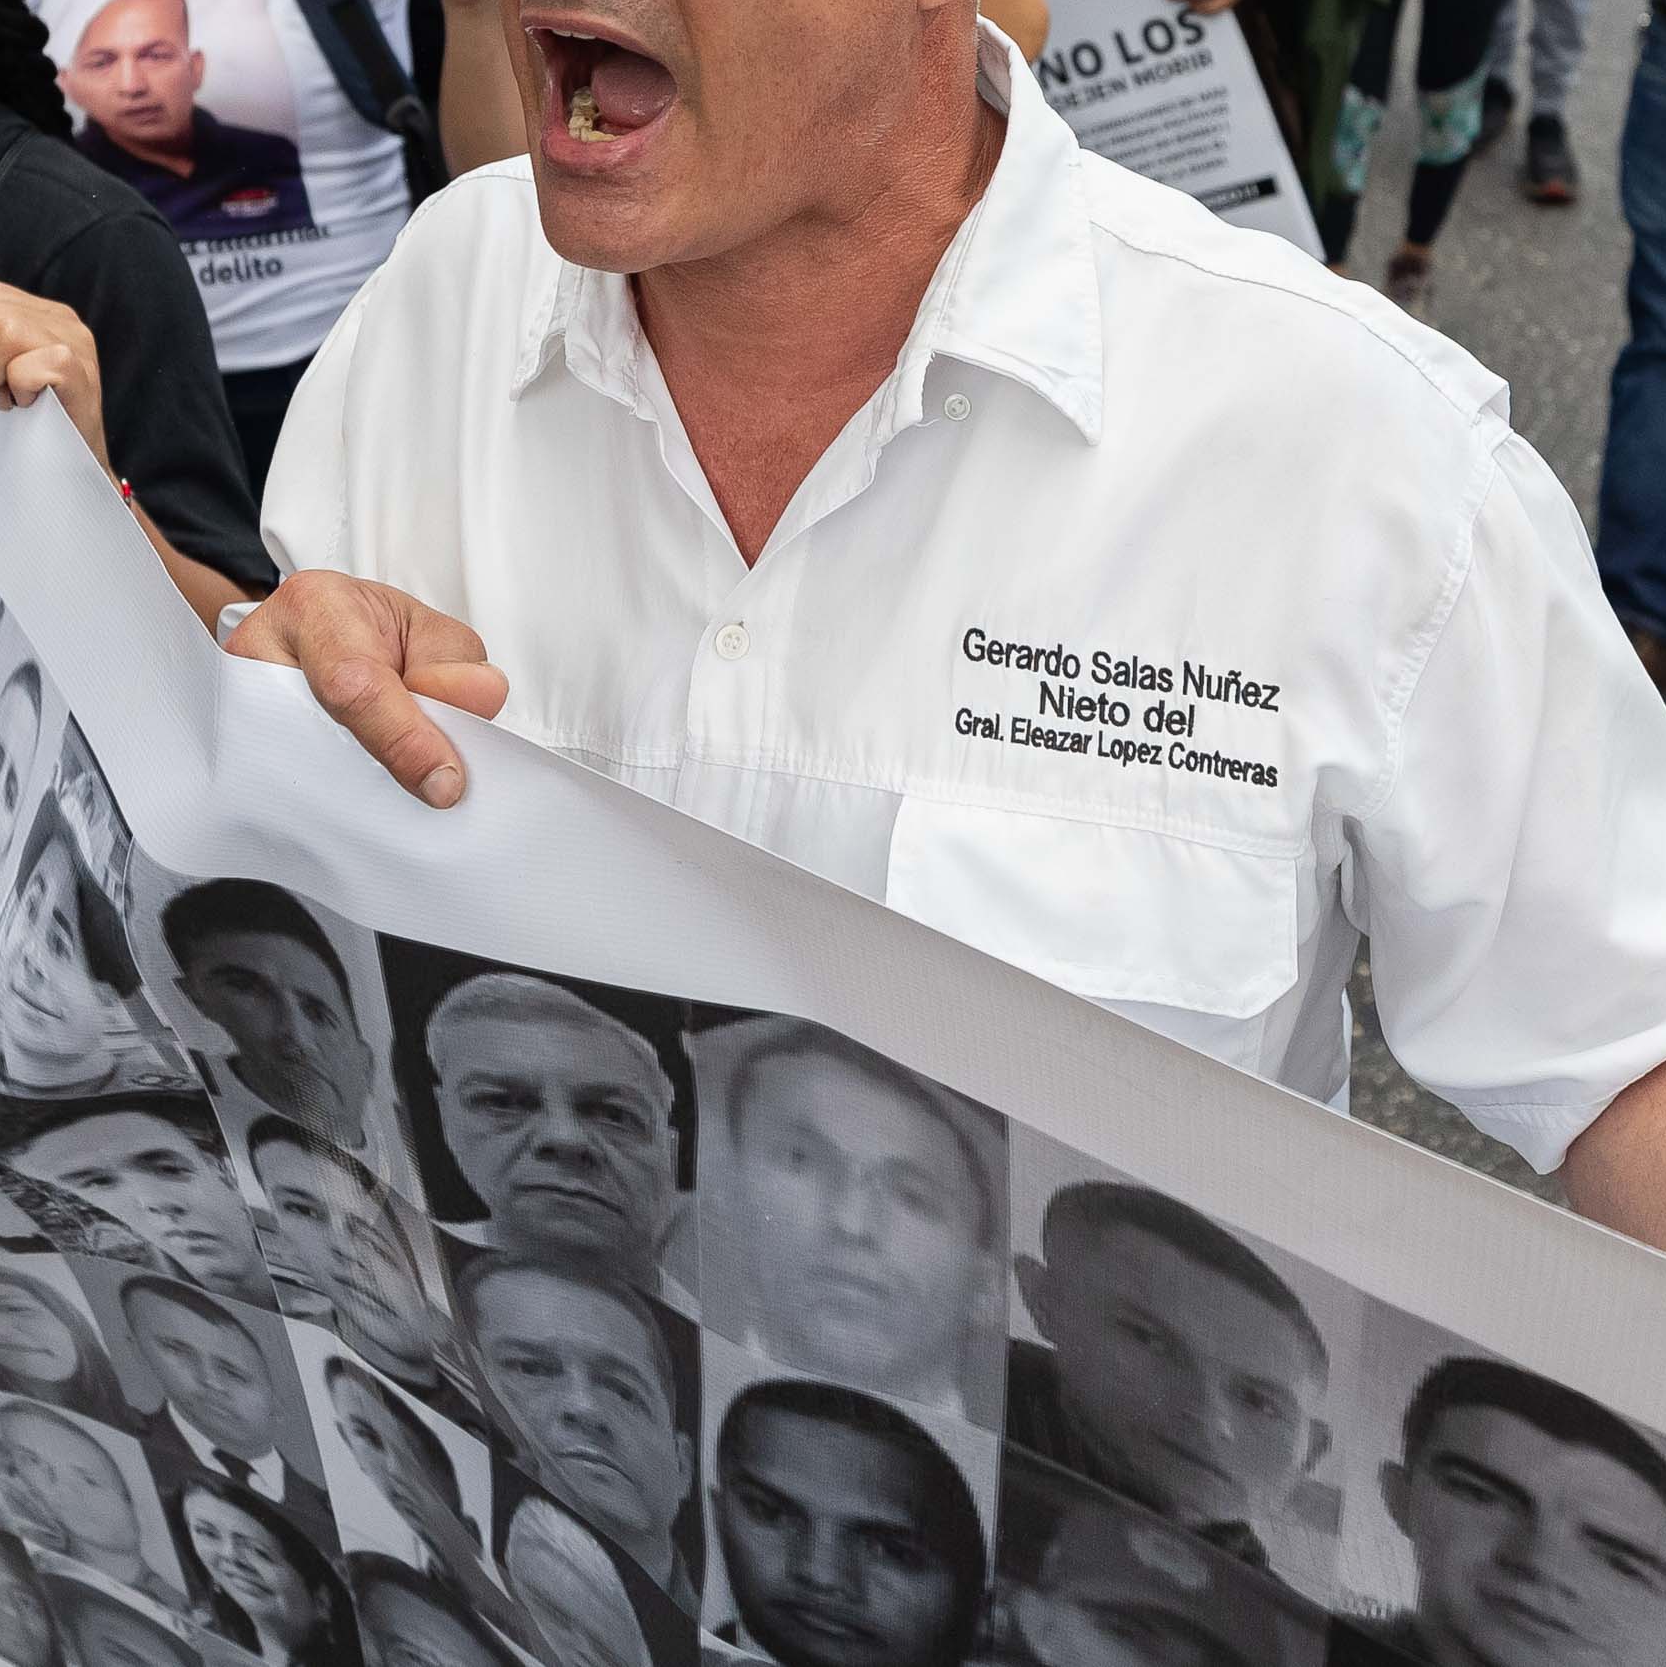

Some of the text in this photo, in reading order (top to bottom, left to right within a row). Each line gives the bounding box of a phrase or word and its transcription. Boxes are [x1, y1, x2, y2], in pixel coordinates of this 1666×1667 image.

[1038, 7, 1206, 90] NO LOS
[198, 254, 283, 286] delito
[962, 626, 1282, 713] Gerardo Salas Nuñez
[1039, 680, 1195, 736] Nieto del
[955, 706, 1279, 789] Gral. Eleazar Lopez Contreras
